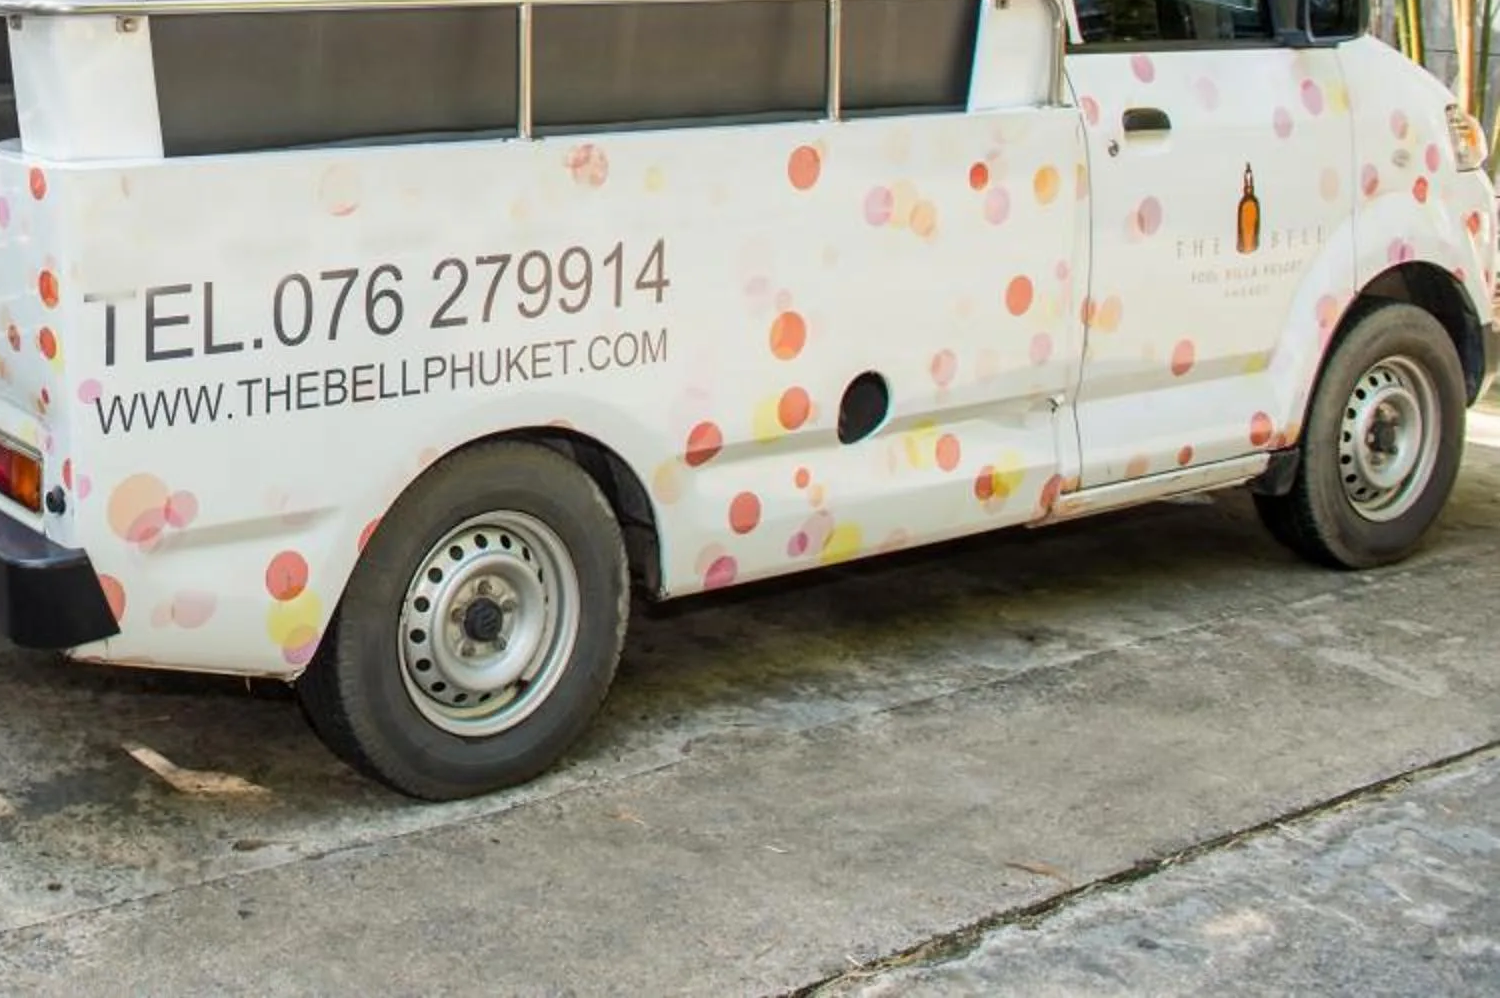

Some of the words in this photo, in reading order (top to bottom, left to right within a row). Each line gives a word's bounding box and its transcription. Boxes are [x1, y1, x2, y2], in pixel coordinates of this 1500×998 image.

[83, 264, 404, 367] TEL.076
[429, 238, 671, 329] 279914
[95, 329, 669, 435] WWW.THEBELLPHUKET.COM
